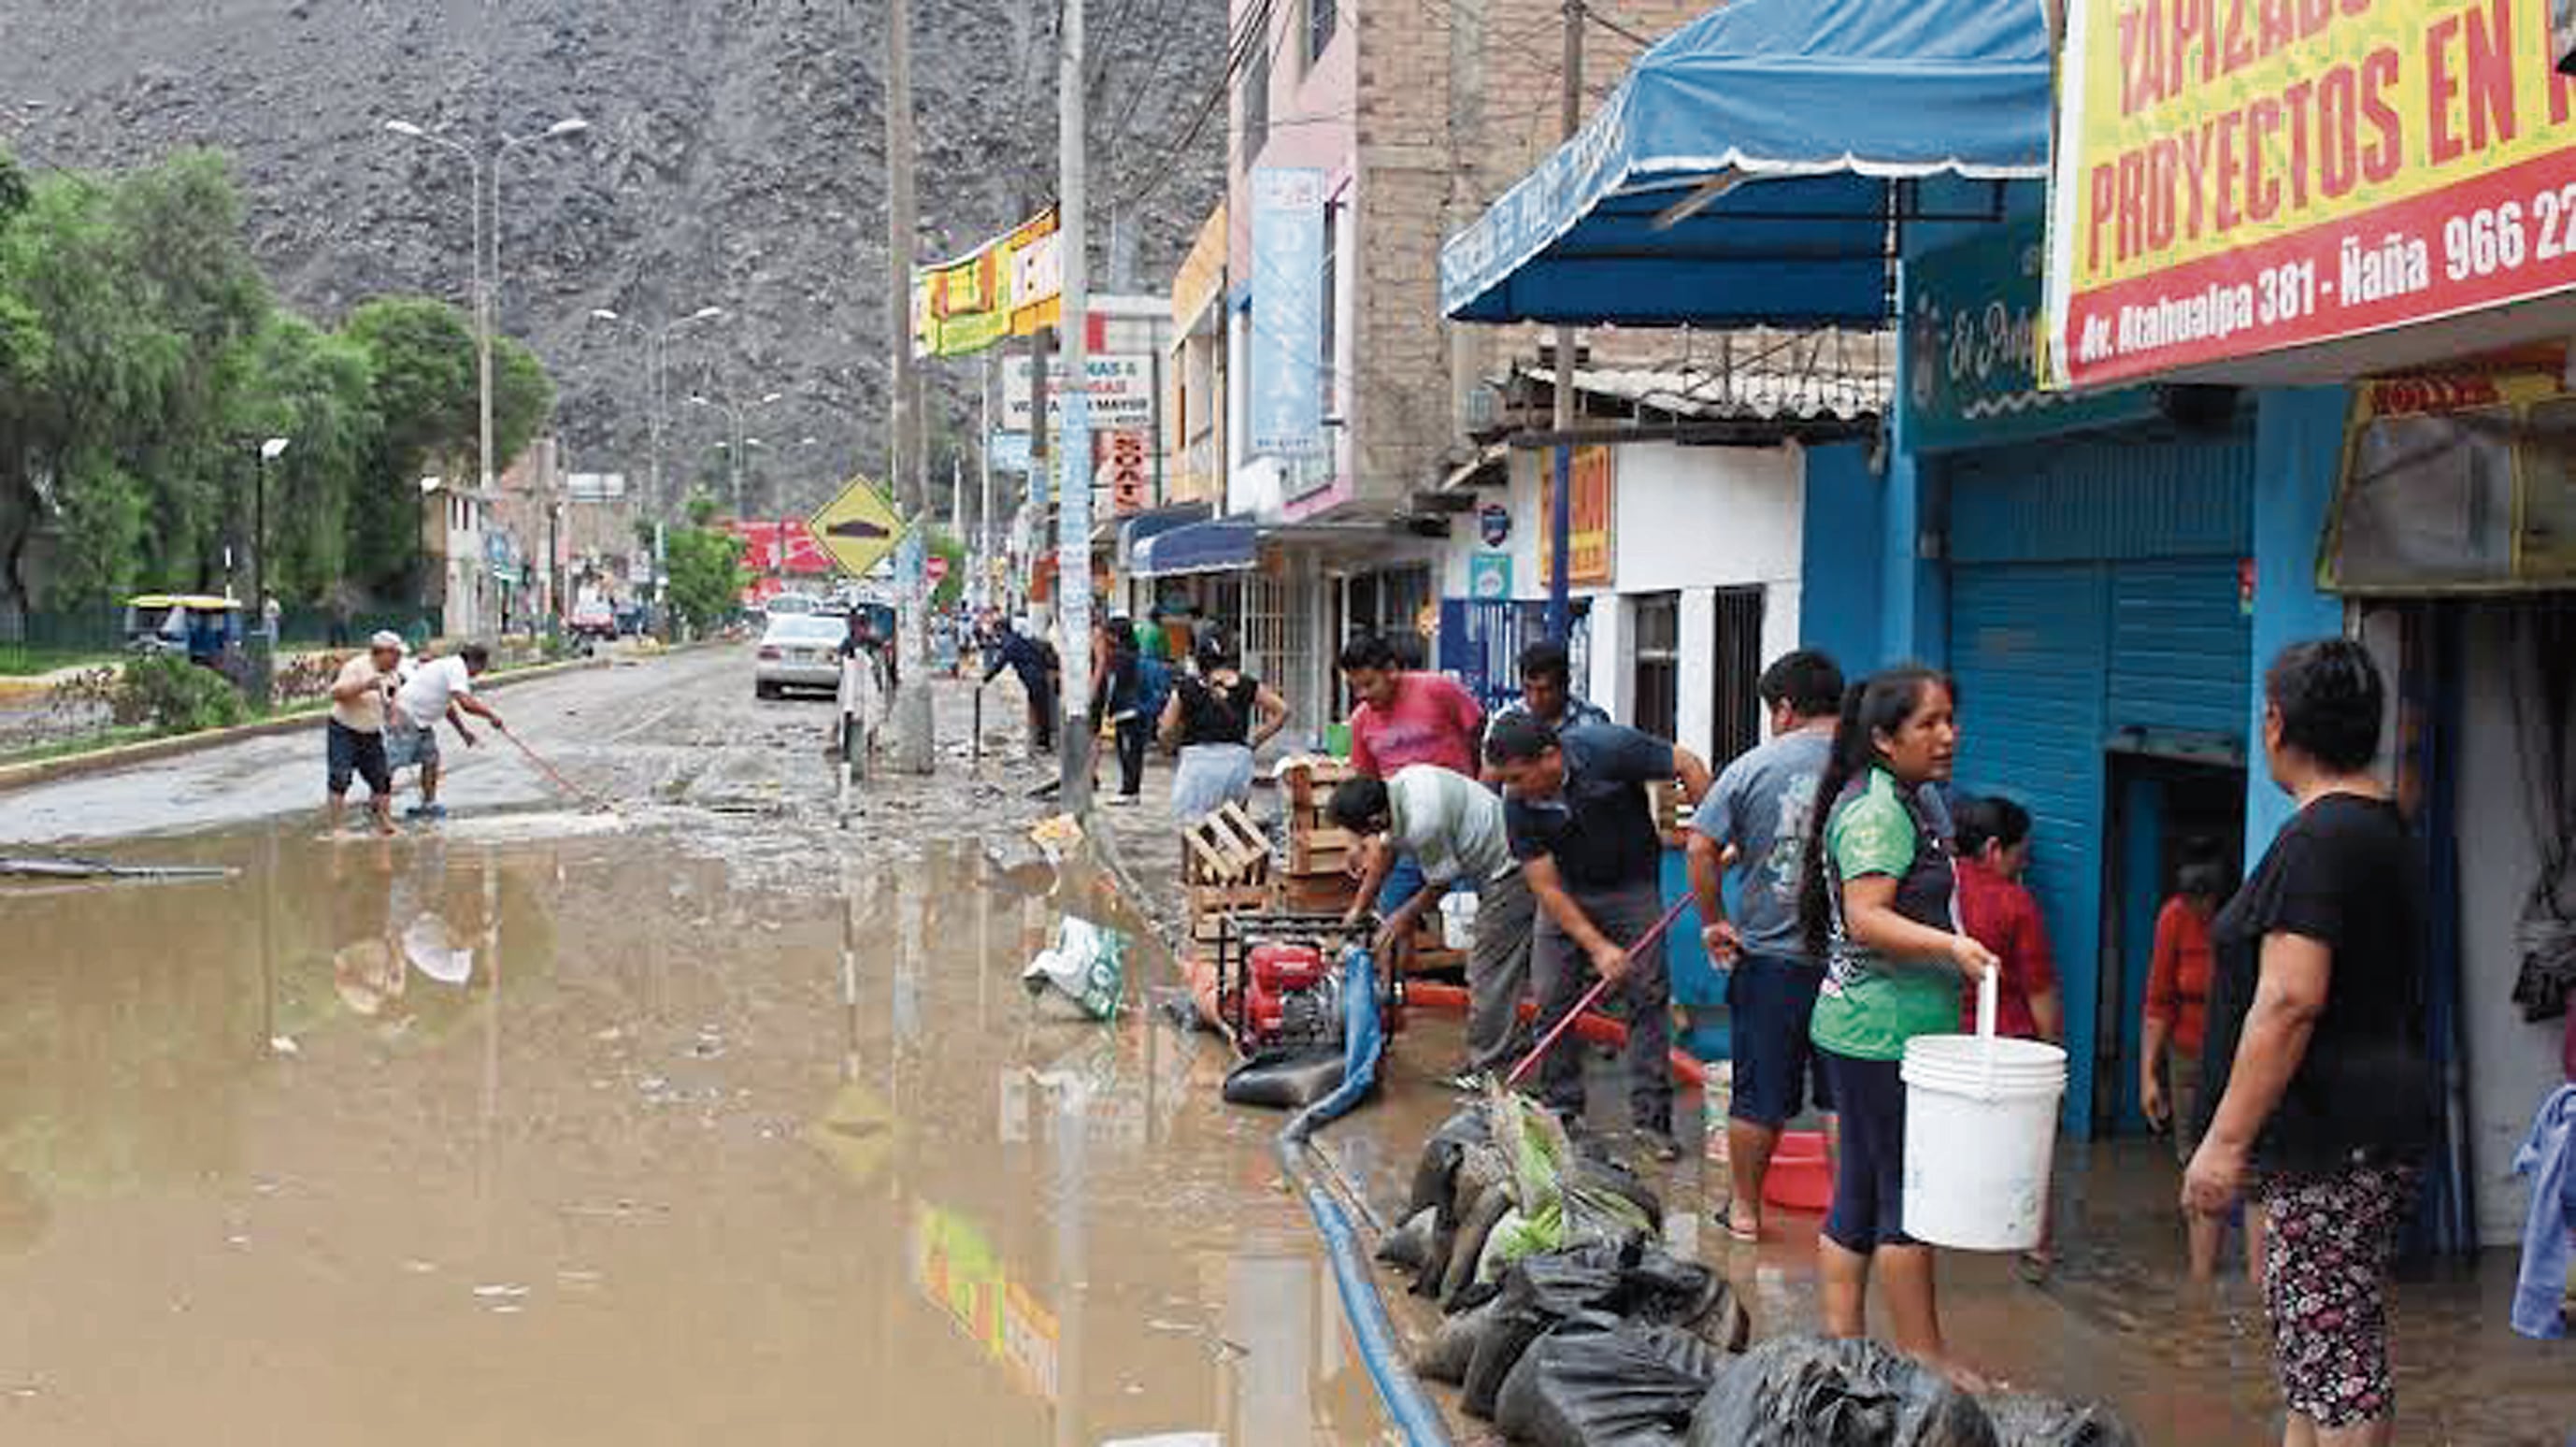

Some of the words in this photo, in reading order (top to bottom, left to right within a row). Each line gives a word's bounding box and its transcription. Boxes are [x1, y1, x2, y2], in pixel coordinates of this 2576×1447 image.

[2089, 46, 2401, 271] PROYECTOS
[2428, 0, 2514, 168] EN
[2119, 0, 2370, 116] TAPIZA
[2081, 313, 2114, 363] Av.
[2119, 282, 2254, 353] Atahualpa
[2257, 259, 2314, 324] 381
[2340, 233, 2430, 307] Ñaña
[2445, 201, 2525, 280] 966
